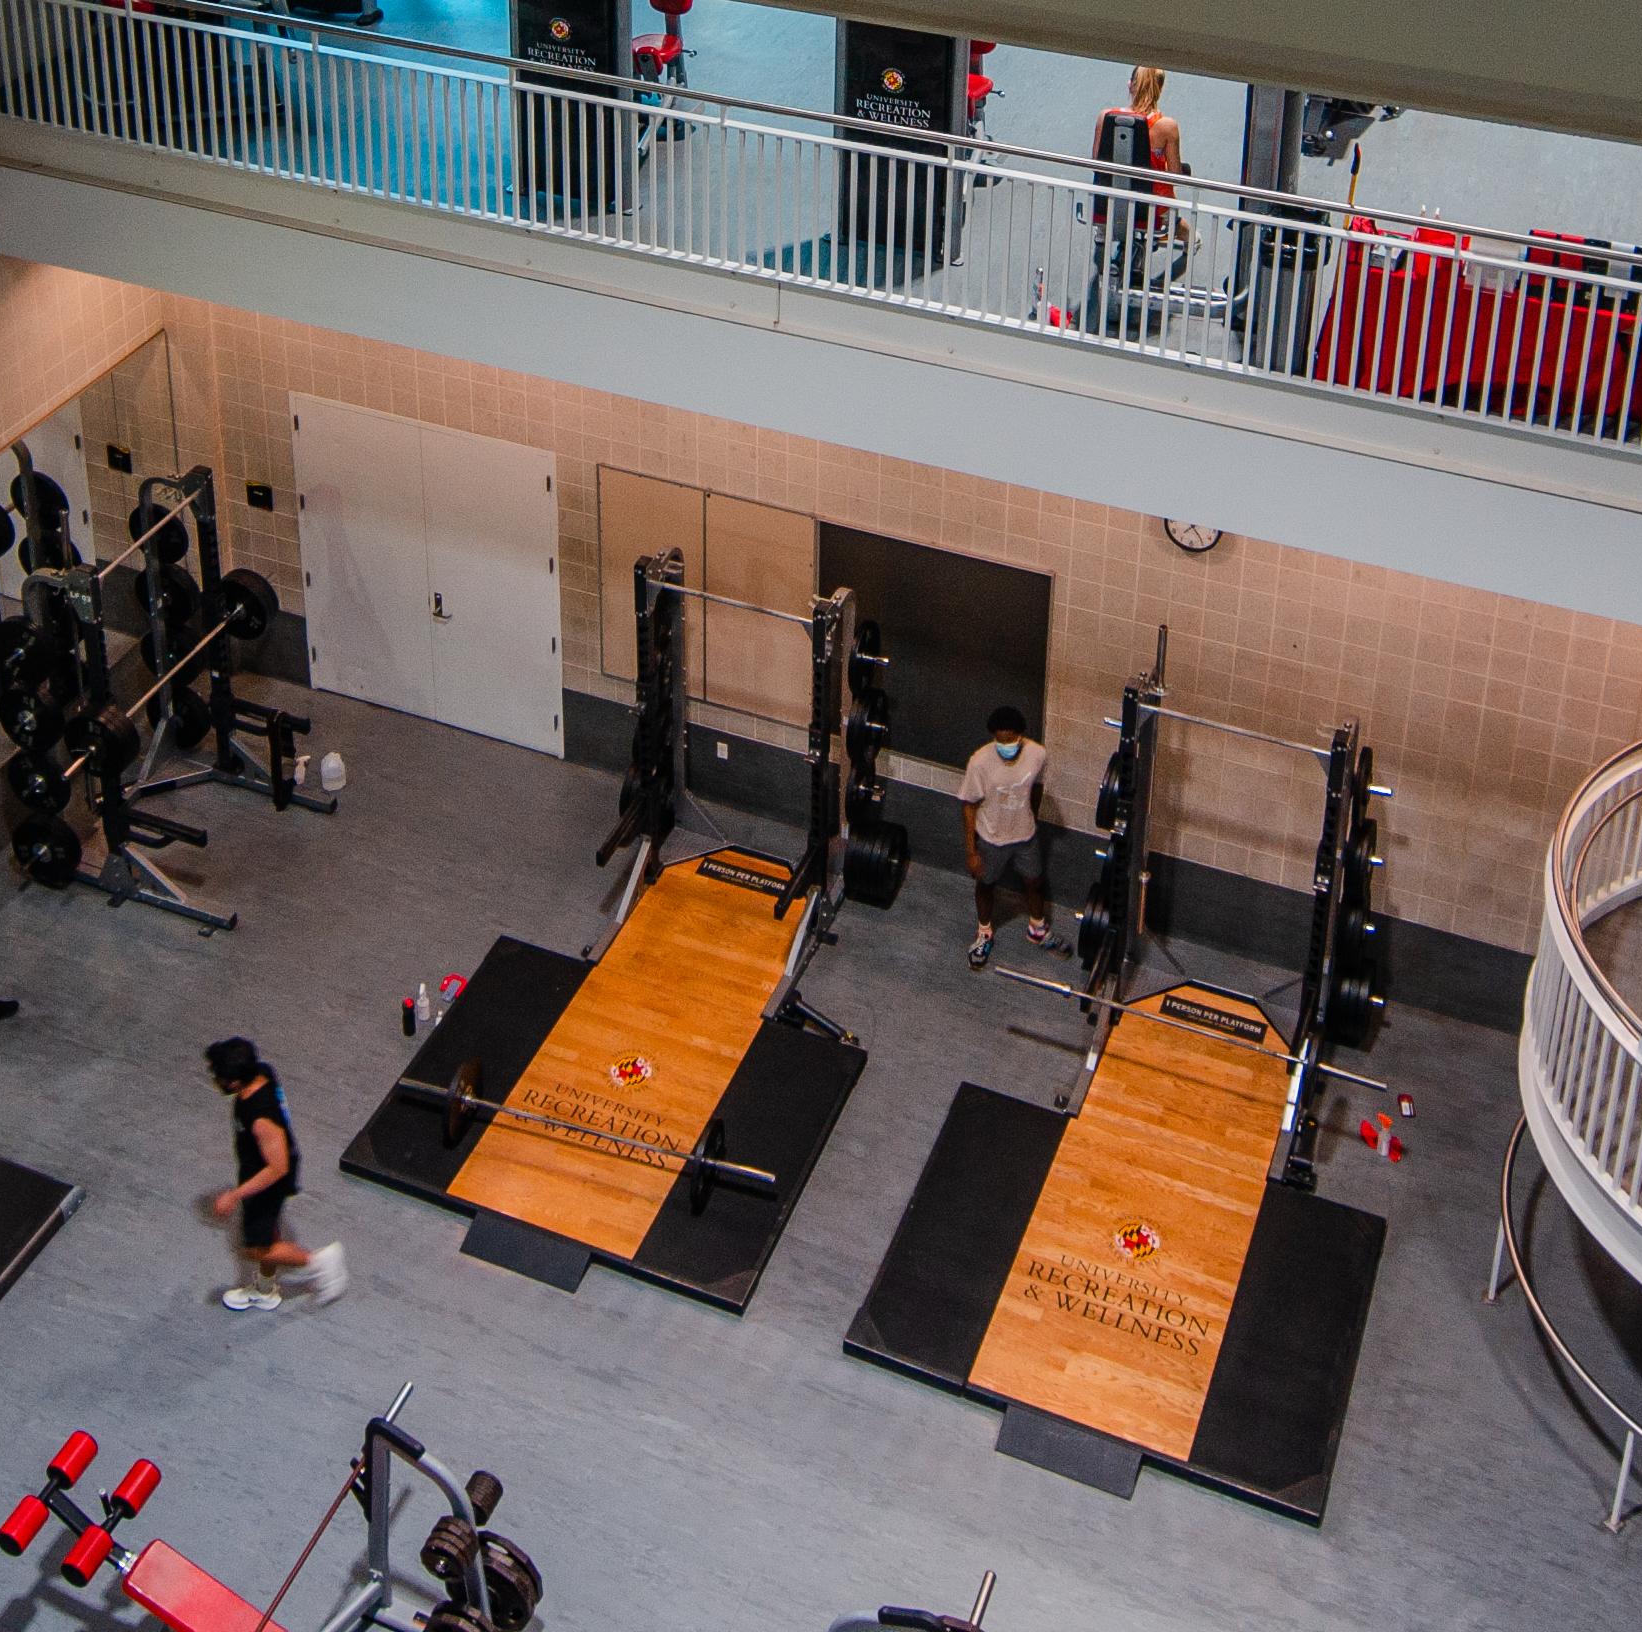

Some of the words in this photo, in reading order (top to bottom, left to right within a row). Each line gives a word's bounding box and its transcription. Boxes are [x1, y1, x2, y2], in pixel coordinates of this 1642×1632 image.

[527, 46, 596, 66] RECREATION
[536, 41, 586, 56] UNIVERSITY
[856, 98, 931, 119] RECREATION
[866, 93, 920, 108] UNIVERSITY
[857, 109, 865, 118] &
[869, 110, 929, 128] WELLNESS
[708, 863, 736, 876] PERSON
[736, 871, 751, 880] PER
[1171, 1002, 1203, 1016] PERSON
[1203, 1011, 1219, 1021] PER
[1220, 1017, 1262, 1034] PLATFORM
[555, 1083, 668, 1127] UNIVERSITY
[522, 1089, 682, 1152] RECREATION
[1060, 1255, 1189, 1306] UNIVERSITY
[1028, 1260, 1211, 1337] RECREATION
[1024, 1284, 1044, 1302] &
[1056, 1291, 1202, 1356] WELLNESS
